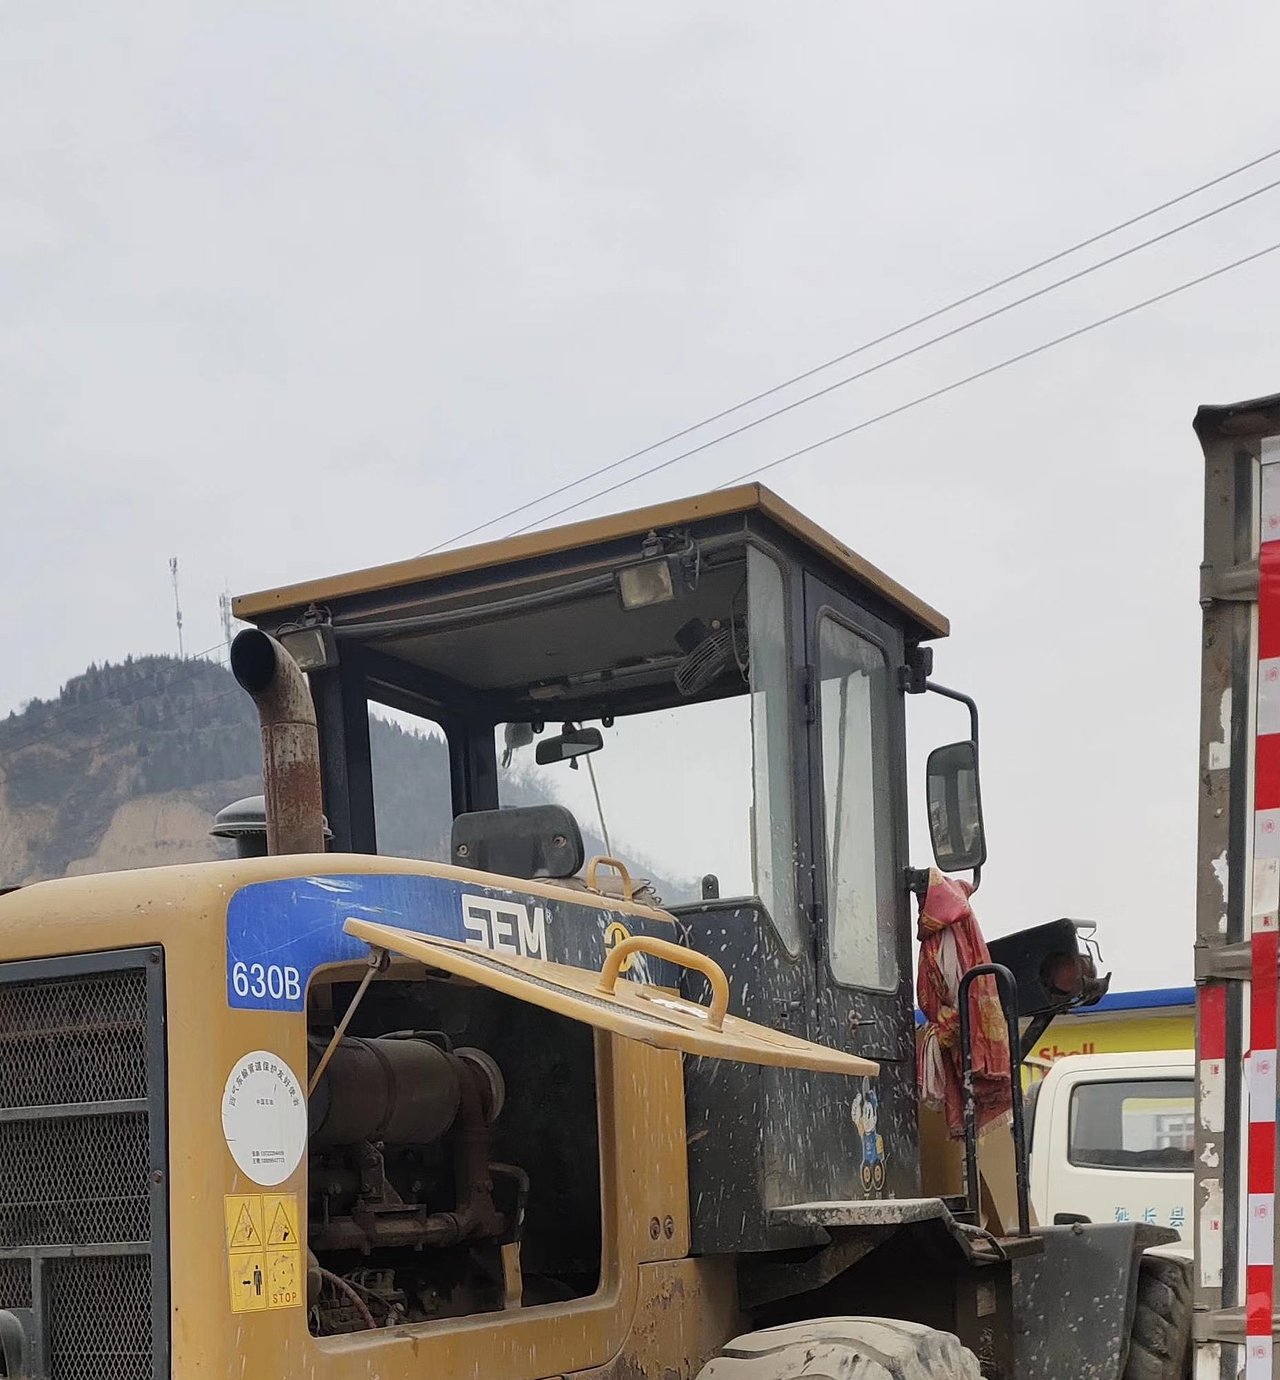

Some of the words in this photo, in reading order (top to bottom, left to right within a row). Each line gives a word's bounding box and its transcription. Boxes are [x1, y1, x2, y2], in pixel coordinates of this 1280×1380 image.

[461, 893, 548, 961] SEM
[232, 961, 301, 1001] 630B
[272, 1292, 298, 1304] STOP
